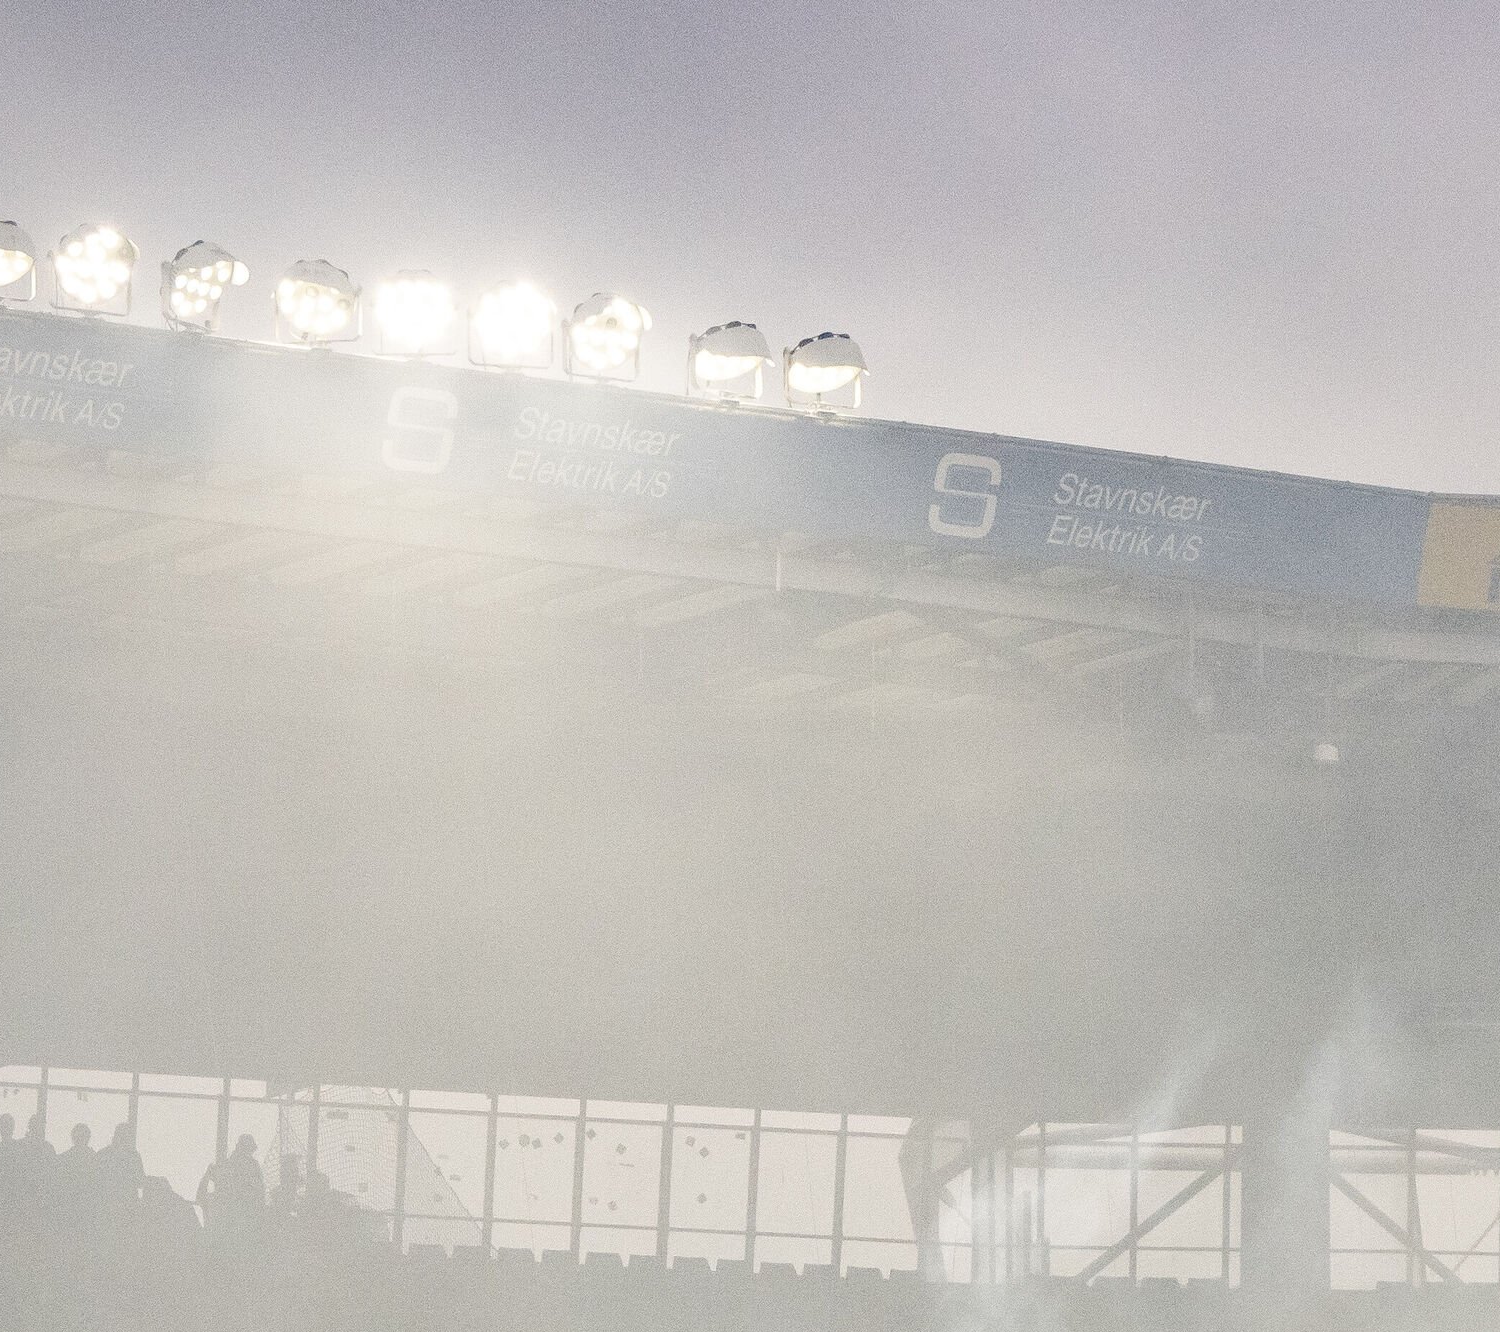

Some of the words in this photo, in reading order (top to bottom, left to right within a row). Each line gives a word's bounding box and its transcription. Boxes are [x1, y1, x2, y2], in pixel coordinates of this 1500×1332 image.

[72, 398, 126, 431] A/S
[510, 406, 681, 459] Stavnskær
[506, 448, 622, 493] Elektrik
[1052, 471, 1213, 523] Stavnskær
[1046, 514, 1157, 558] Elektrik
[1157, 533, 1202, 564] A/S
